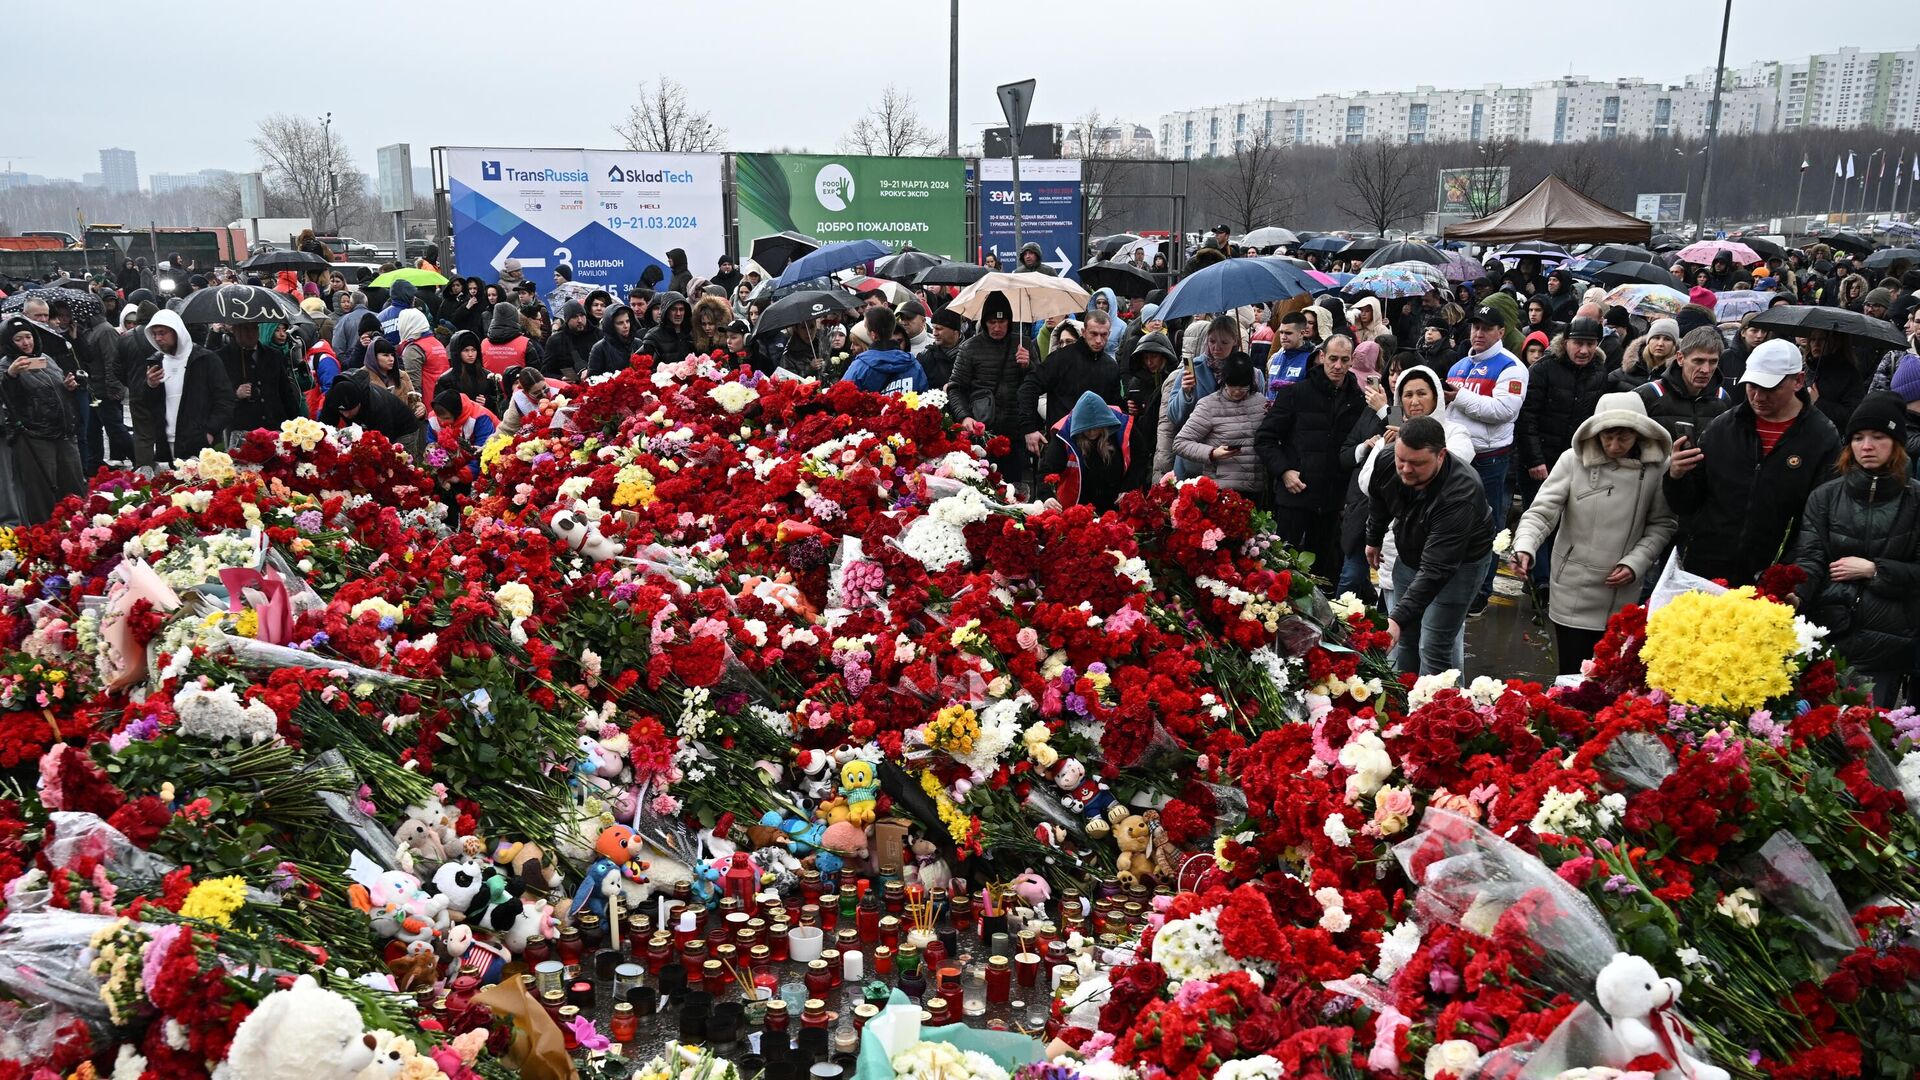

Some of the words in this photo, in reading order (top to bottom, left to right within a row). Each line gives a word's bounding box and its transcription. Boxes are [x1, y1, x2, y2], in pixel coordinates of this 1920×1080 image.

[505, 168, 589, 182] TransRussia
[626, 169, 693, 183] SkladTech
[901, 181, 929, 189] МАРТА
[930, 181, 949, 189] 2024
[816, 222, 854, 233] ДОБРО
[856, 222, 929, 232] ПОЖАЛОВАТЬ
[553, 247, 573, 272] 3
[577, 260, 624, 268] ПАВИЛЬОН
